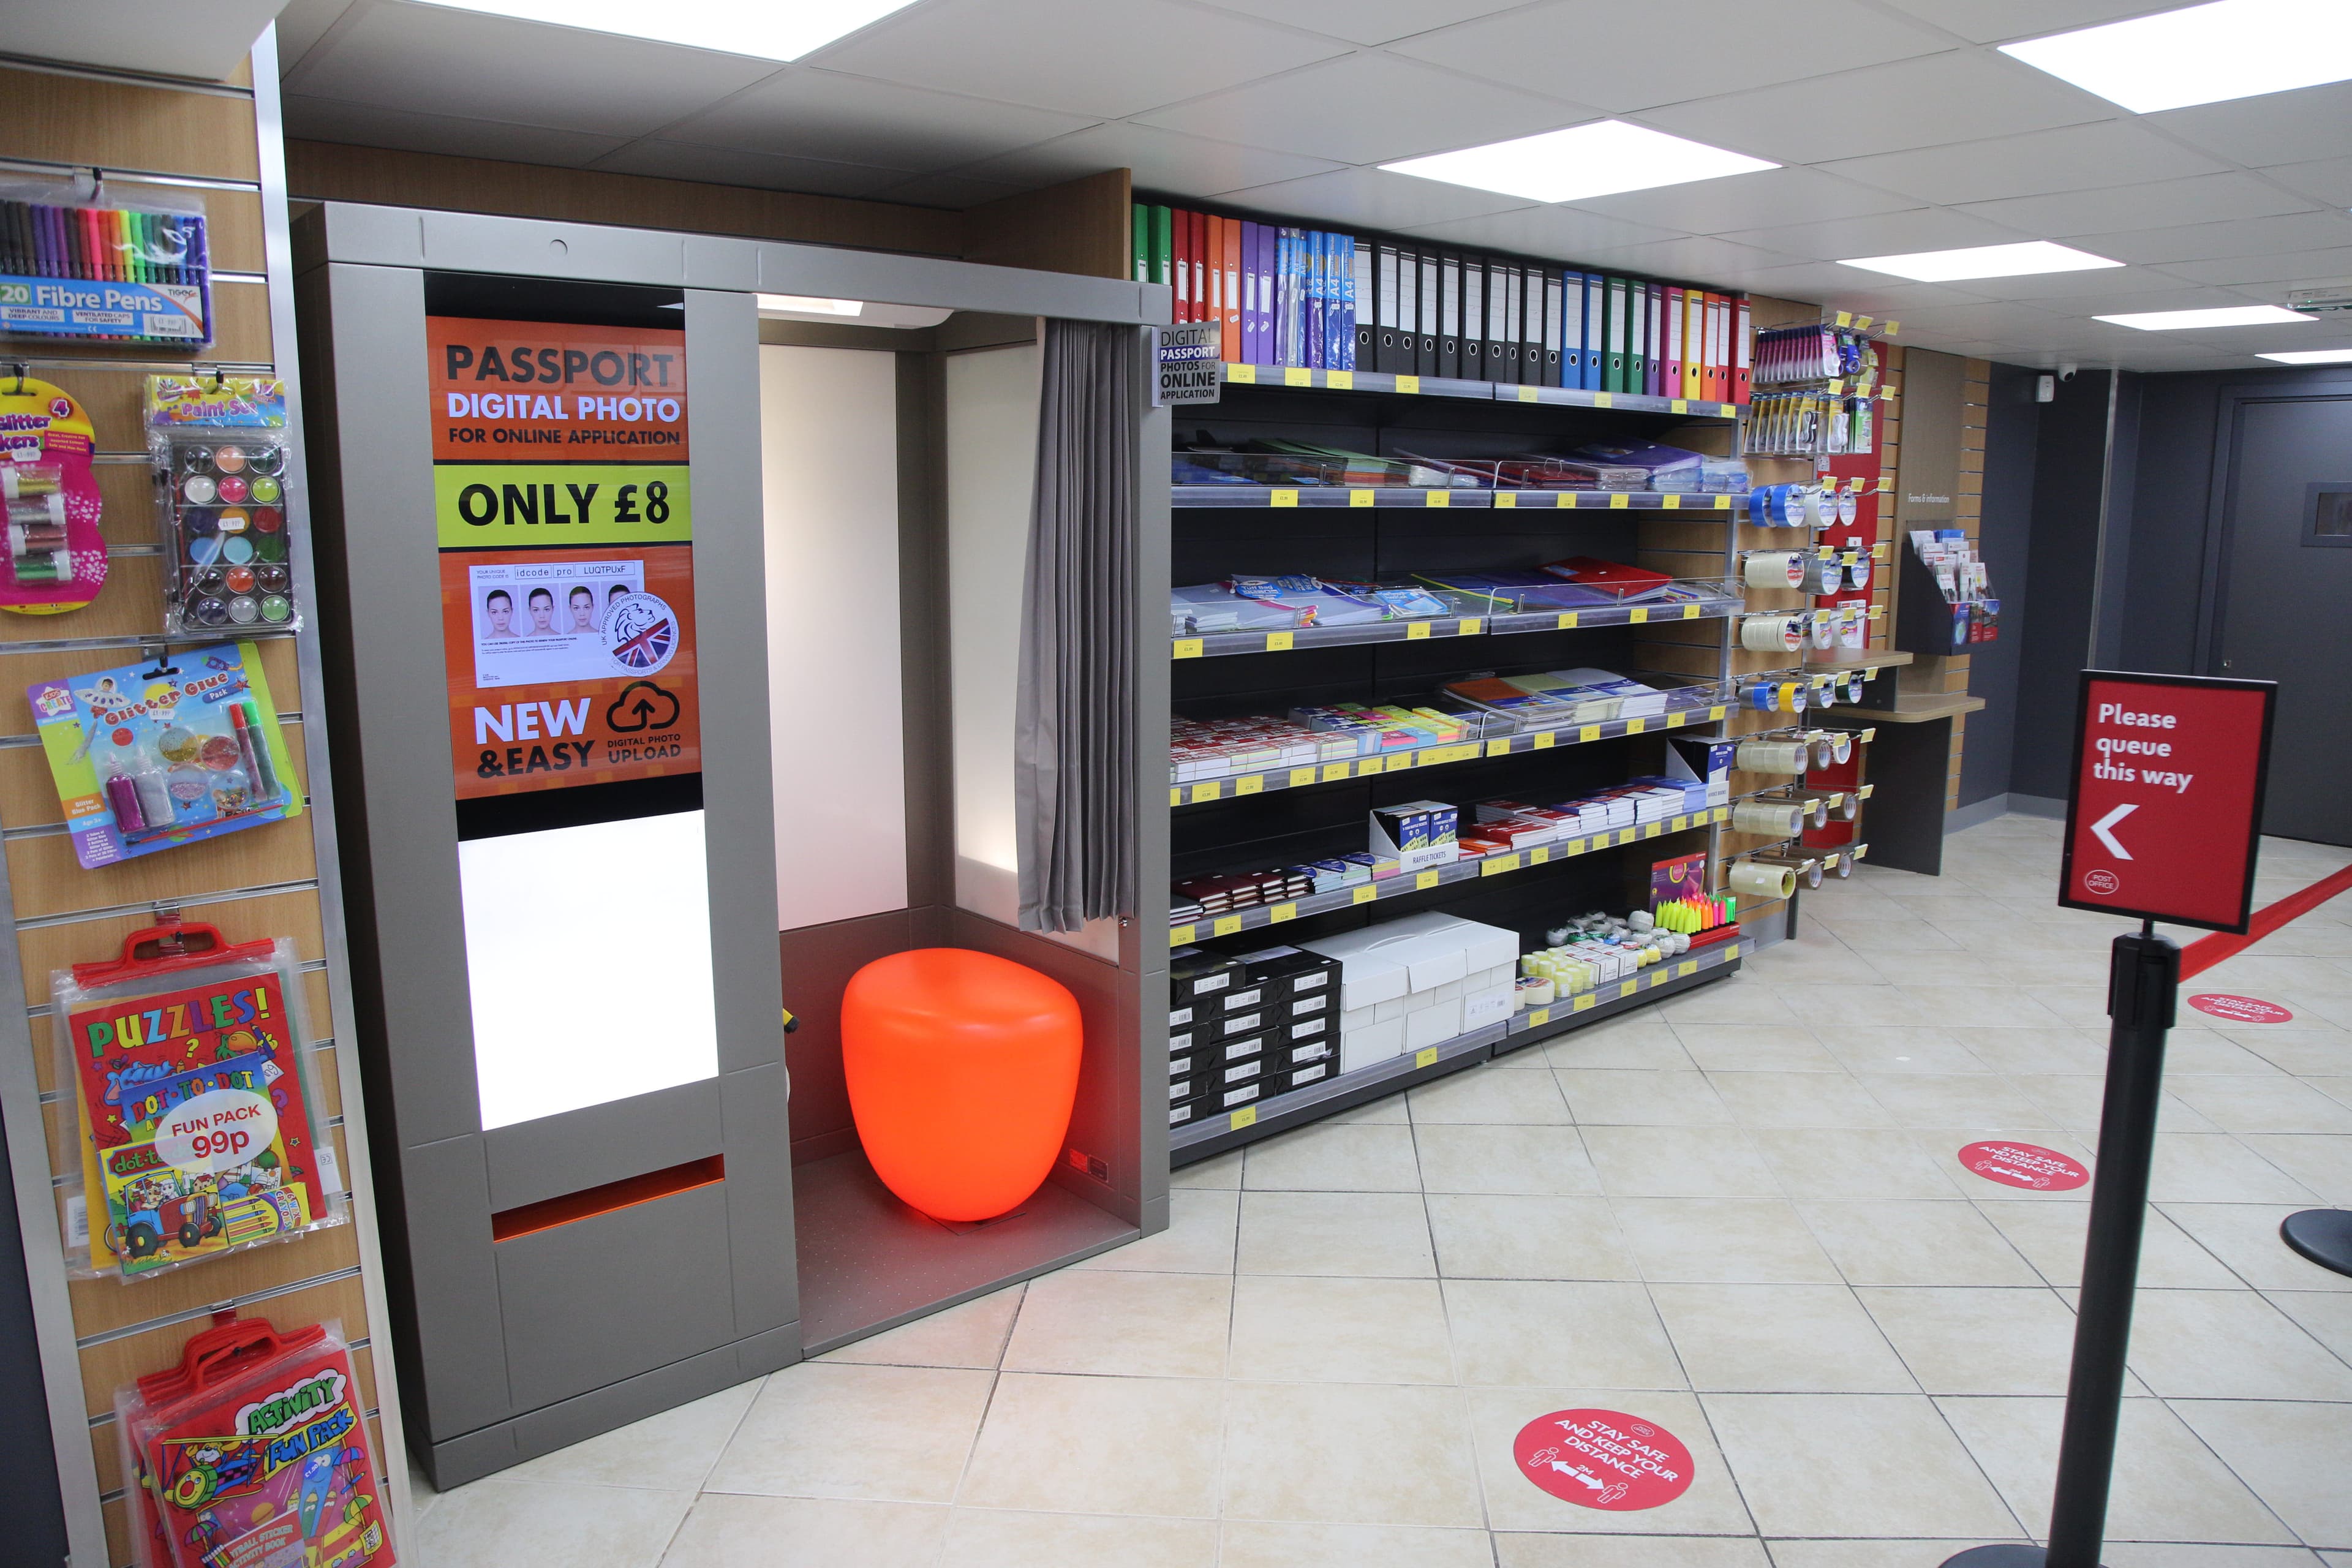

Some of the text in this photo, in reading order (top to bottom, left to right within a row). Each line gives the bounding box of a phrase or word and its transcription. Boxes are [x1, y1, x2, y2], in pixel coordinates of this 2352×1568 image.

[1316, 277, 1323, 296] A4
[1330, 279, 1340, 297] A4
[1344, 281, 1354, 298] A4
[1, 285, 163, 312] 20 Fibre Pens
[1161, 328, 1215, 347] DIGITAL
[1161, 346, 1216, 360] PASSPORT
[445, 344, 674, 387] PASSPORT
[1161, 361, 1216, 372] PHOTOS FOR
[1161, 372, 1216, 388] ONLINE
[1160, 389, 1215, 400] APPLICATION
[53, 400, 69, 417] 4
[181, 399, 258, 418] Paint Set
[448, 393, 680, 423] DIGITAL PHOTO
[448, 428, 680, 445] FOR ONLINE APPLICATION
[458, 480, 670, 527] ONLY £8
[1908, 492, 1950, 503] Forms & information
[516, 568, 549, 577] idcode
[557, 568, 572, 577] pro
[601, 594, 666, 646] UK APPROVED PHOTOGRAPHS
[40, 695, 73, 712] CREATE
[43, 689, 61, 701] KIDS
[104, 672, 229, 726] Glitter Glue
[209, 688, 228, 700] Pack
[473, 697, 591, 745] NEW
[2098, 703, 2177, 729] Please
[607, 733, 681, 748] DIGITAL PHOTO
[2095, 737, 2173, 758] queue
[477, 740, 596, 778] &EASY
[608, 744, 682, 764] UPLOAD
[2093, 757, 2195, 794] this way
[75, 799, 94, 808] Glitter
[1413, 851, 1446, 864] RAFFLE TICKETS
[2088, 880, 2115, 890] OFFICE
[2093, 874, 2113, 883] POST
[2213, 1002, 2266, 1014] DISTANCE
[2253, 1007, 2284, 1016] YOUR
[86, 986, 271, 1058] PUZZLES!
[172, 1104, 262, 1137] FUN PACK
[192, 1130, 250, 1159] 99p
[1978, 1146, 2080, 1178] AND KEEP YOUR
[1991, 1154, 2056, 1175] DISTANCE
[2000, 1147, 2068, 1168] STAY SAFE
[275, 1190, 293, 1226] CRAYONS
[288, 1200, 301, 1219] WAX
[248, 1376, 339, 1436] ACTIVITY
[268, 1408, 356, 1473] FUN PACK
[1587, 1420, 1670, 1464] STAY SAFE
[1553, 1419, 1679, 1483] AND KEEP YOUR
[1563, 1436, 1645, 1479] DISTANCE
[305, 1464, 318, 1478] £1.50
[1575, 1464, 1595, 1476] 2M
[259, 1524, 293, 1542] STICKER
[230, 1536, 287, 1568] ACTIVITY BOOK
